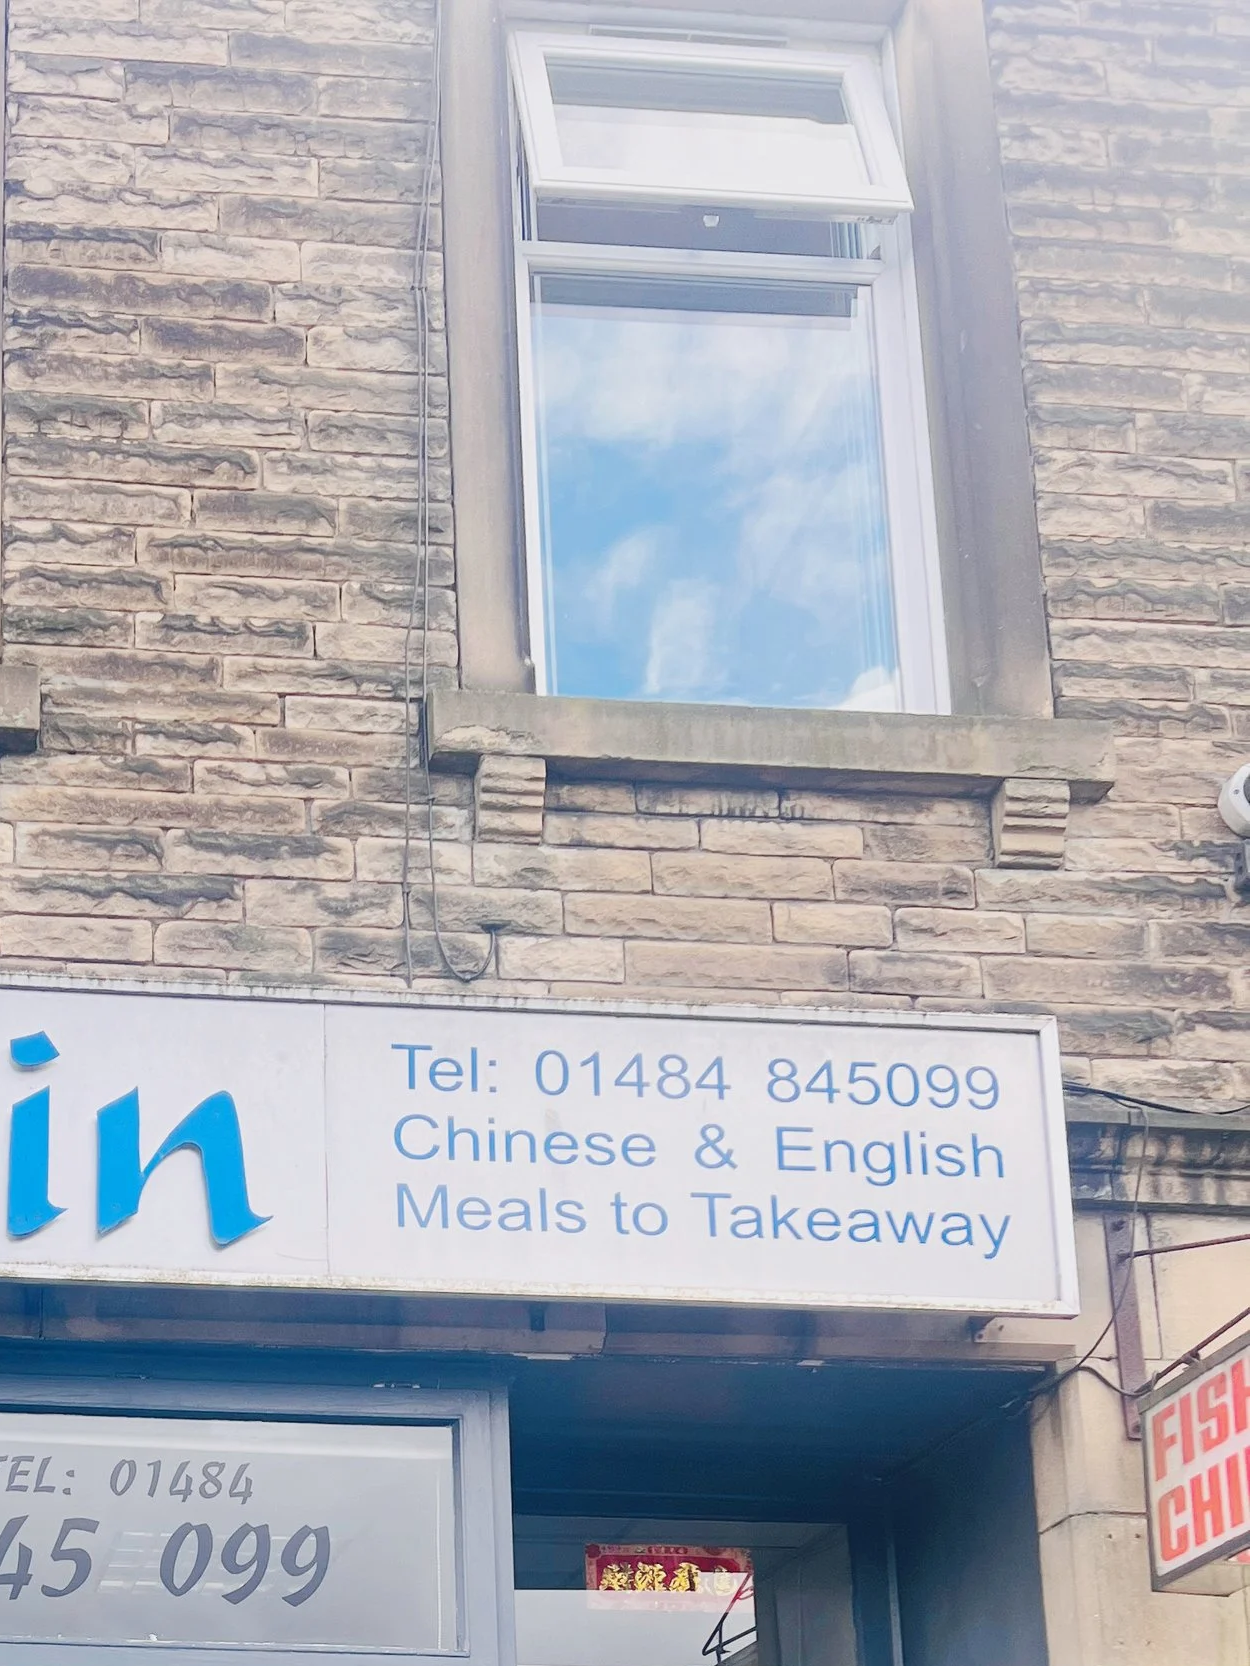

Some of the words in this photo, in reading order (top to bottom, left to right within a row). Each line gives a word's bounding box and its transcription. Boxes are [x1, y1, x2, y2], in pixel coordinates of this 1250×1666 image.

[391, 1043, 498, 1093] Tel:
[534, 1050, 732, 1100] 01484
[767, 1059, 1000, 1110] 845099
[393, 1114, 657, 1167] Chinese
[694, 1124, 737, 1169] &
[776, 1126, 1005, 1186] English
[396, 1184, 587, 1233] Meals
[612, 1192, 668, 1235] to
[690, 1193, 1010, 1260] Takeaway
[109, 1458, 254, 1505] 01484
[1158, 1444, 1250, 1562] CHI
[159, 1521, 332, 1607] 099
